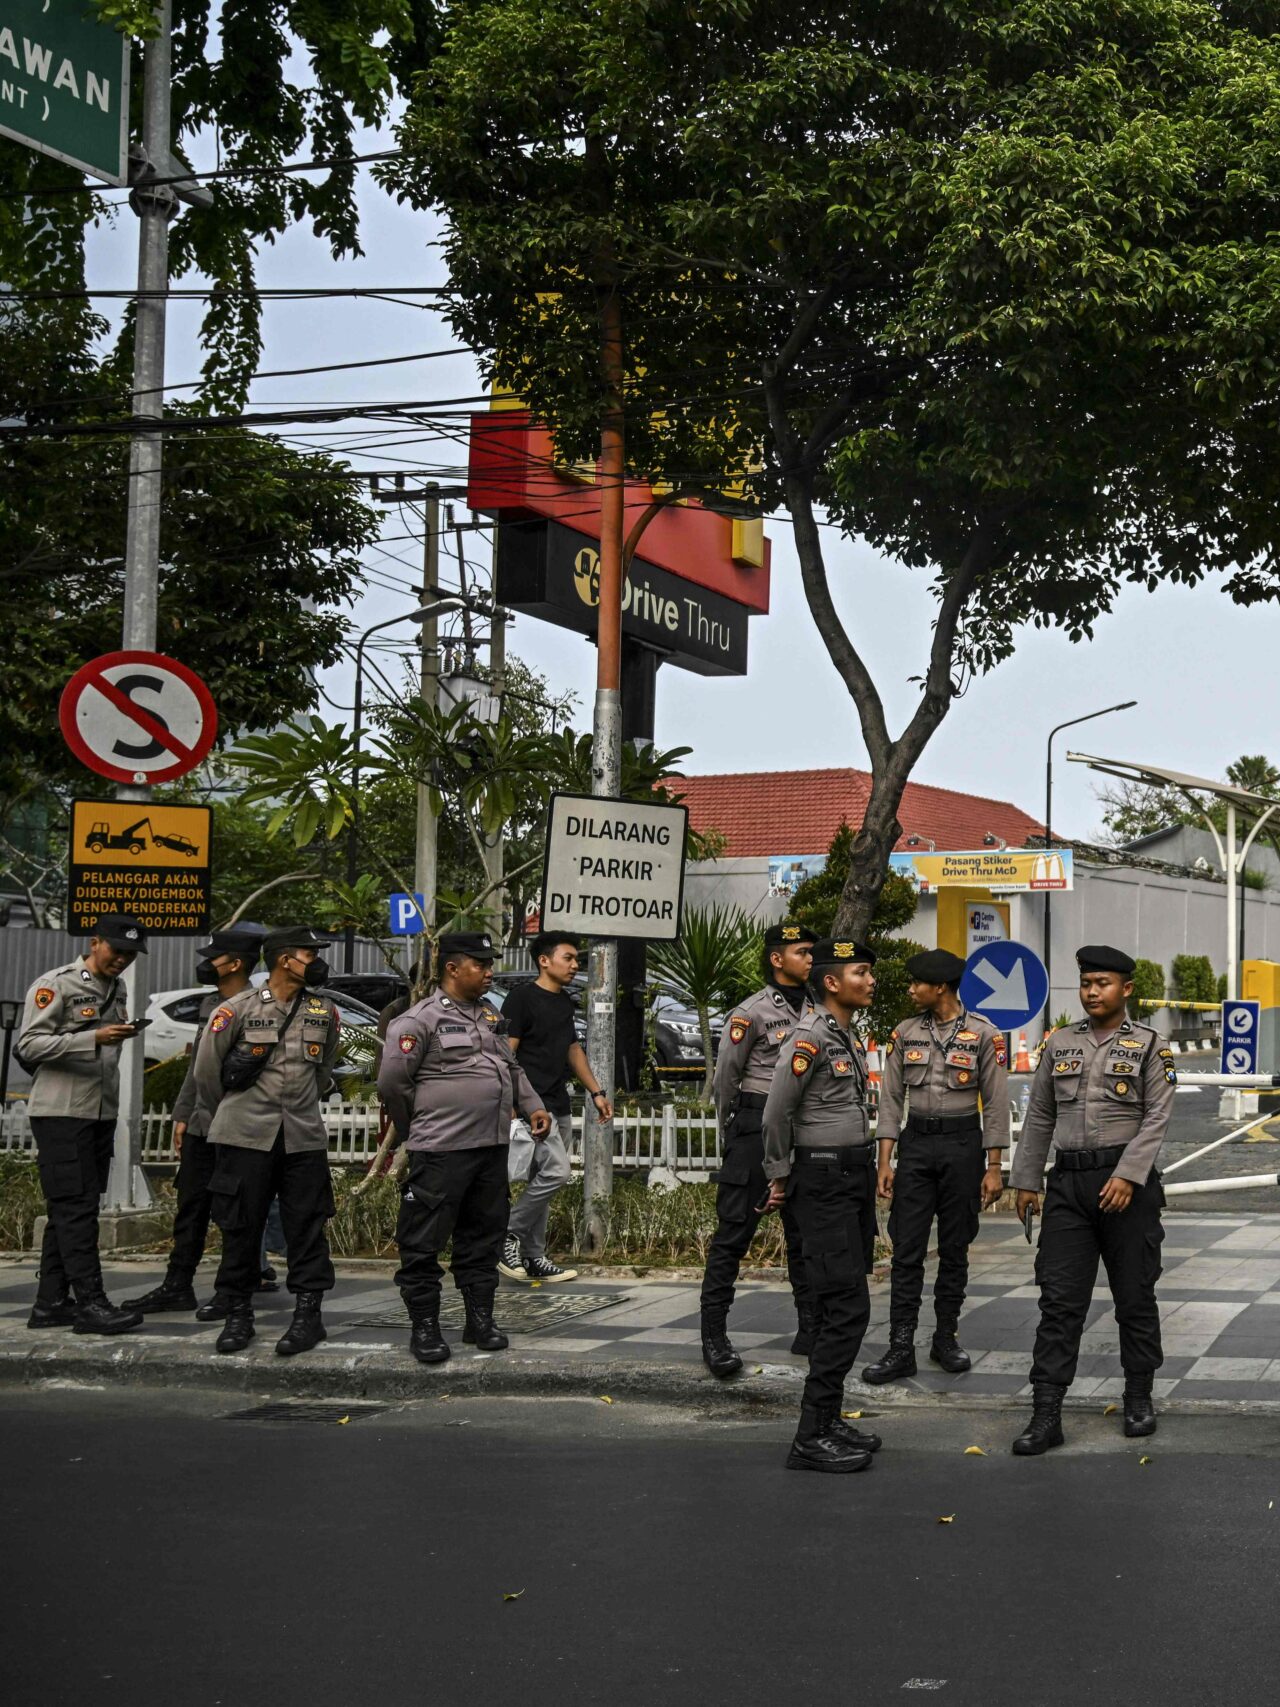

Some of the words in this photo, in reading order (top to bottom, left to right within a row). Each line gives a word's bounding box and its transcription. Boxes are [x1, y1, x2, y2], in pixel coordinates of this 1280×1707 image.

[684, 597, 730, 652] Thru
[566, 816, 671, 846] DILARANG
[945, 856, 981, 867] Pasang
[983, 856, 1013, 865] Stiker
[579, 856, 653, 881] PARKIR
[942, 867, 968, 877] Drive
[970, 867, 993, 876] Thru
[995, 866, 1018, 875] McD
[82, 871, 160, 885] PELANGGAR
[164, 874, 199, 885] AKAN
[76, 887, 204, 900] DIDEREK/DIGEMBOK
[73, 901, 118, 913] DENDA
[124, 902, 206, 913] PENDEREKAN
[550, 893, 572, 913] DI
[579, 894, 674, 920] TROTOAR
[399, 898, 417, 929] P
[304, 1018, 329, 1027] POLRI
[950, 1042, 979, 1053] POLRI
[1055, 1048, 1084, 1058] DIFTA
[1109, 1049, 1142, 1060] POLRI
